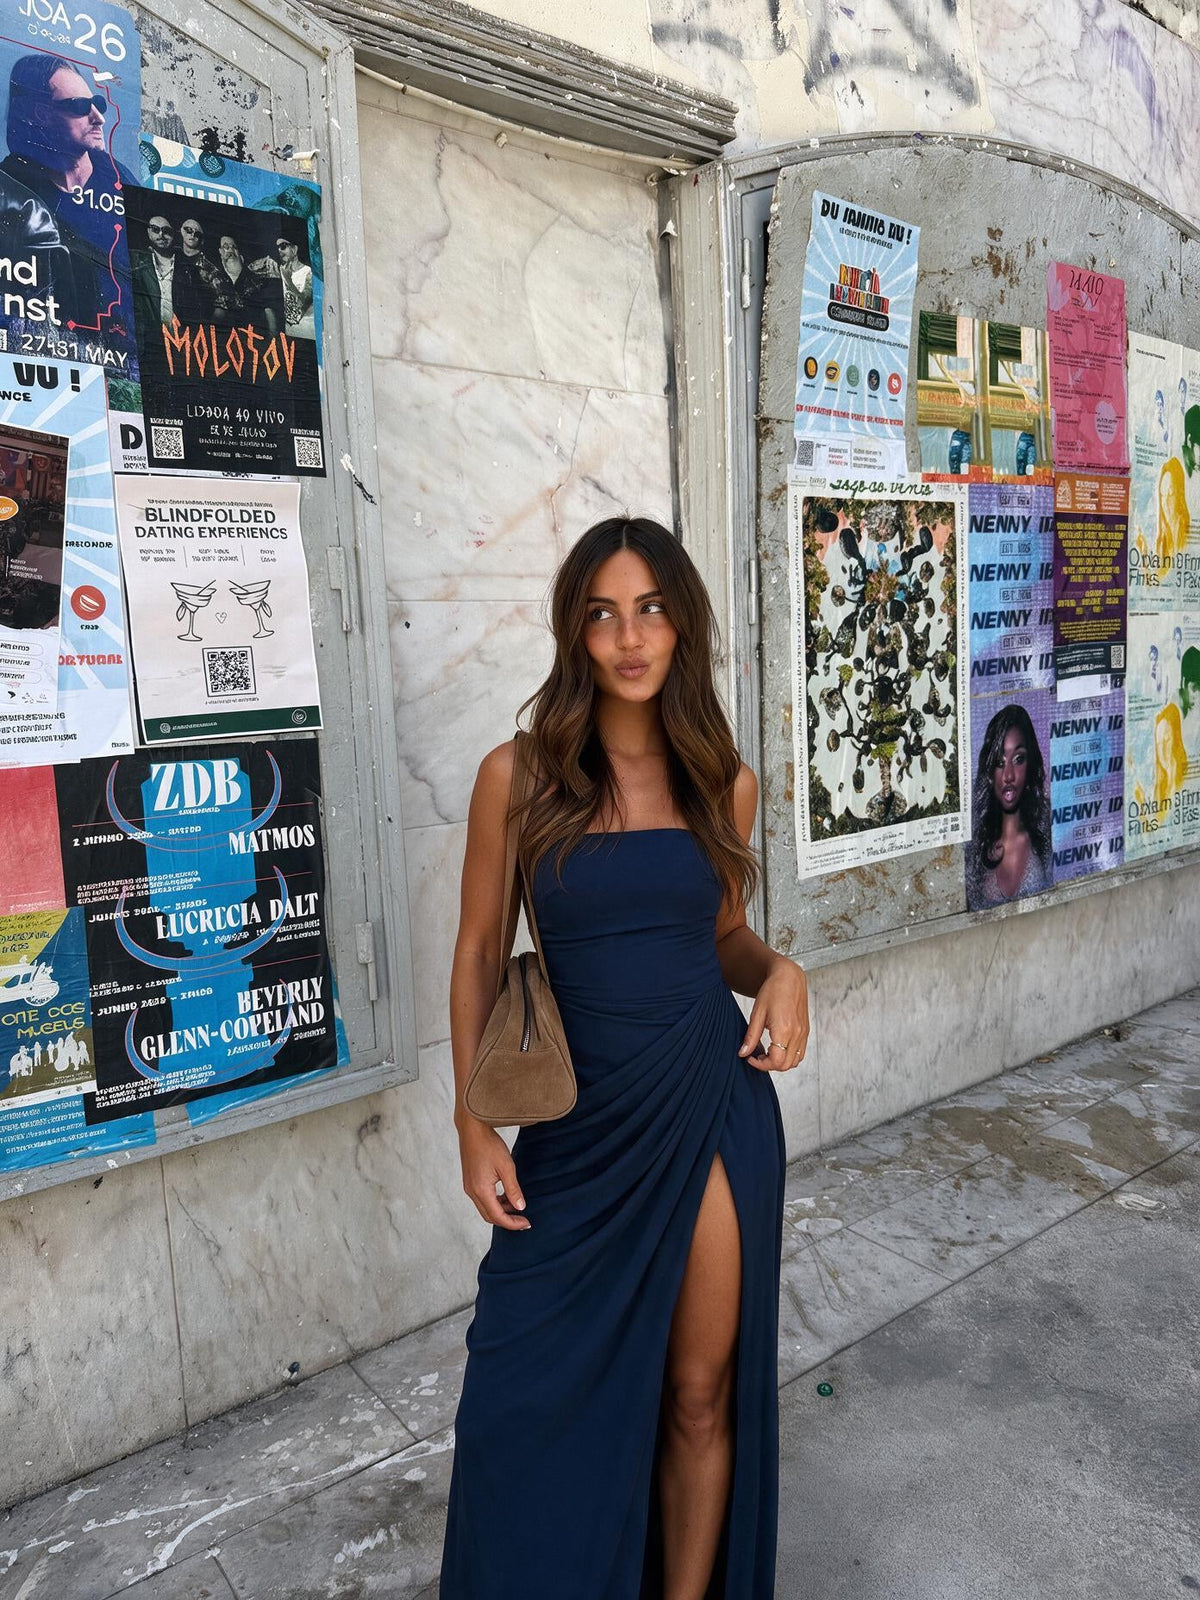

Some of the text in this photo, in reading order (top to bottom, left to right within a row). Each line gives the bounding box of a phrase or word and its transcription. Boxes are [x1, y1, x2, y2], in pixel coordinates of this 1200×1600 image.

[74, 13, 126, 61] 26
[72, 185, 125, 216] 31.05
[144, 507, 276, 524] BLINDFOLDED
[969, 515, 1032, 533] NENNY
[135, 526, 195, 539] DATING
[970, 563, 1032, 582] NENNY
[970, 609, 1033, 631] NENNY
[971, 654, 1033, 678] NENNY
[1050, 714, 1123, 739] NENNY ID
[1050, 756, 1123, 782] NENNY ID
[151, 759, 242, 812] ZDB
[1051, 796, 1124, 825] NENNY ID
[228, 825, 316, 856] MATMOS
[1051, 836, 1124, 867] NENNY ID
[269, 892, 320, 922] DALT
[237, 976, 325, 1014] BEVERLY
[140, 1003, 326, 1061] GLENN-COPELAND
